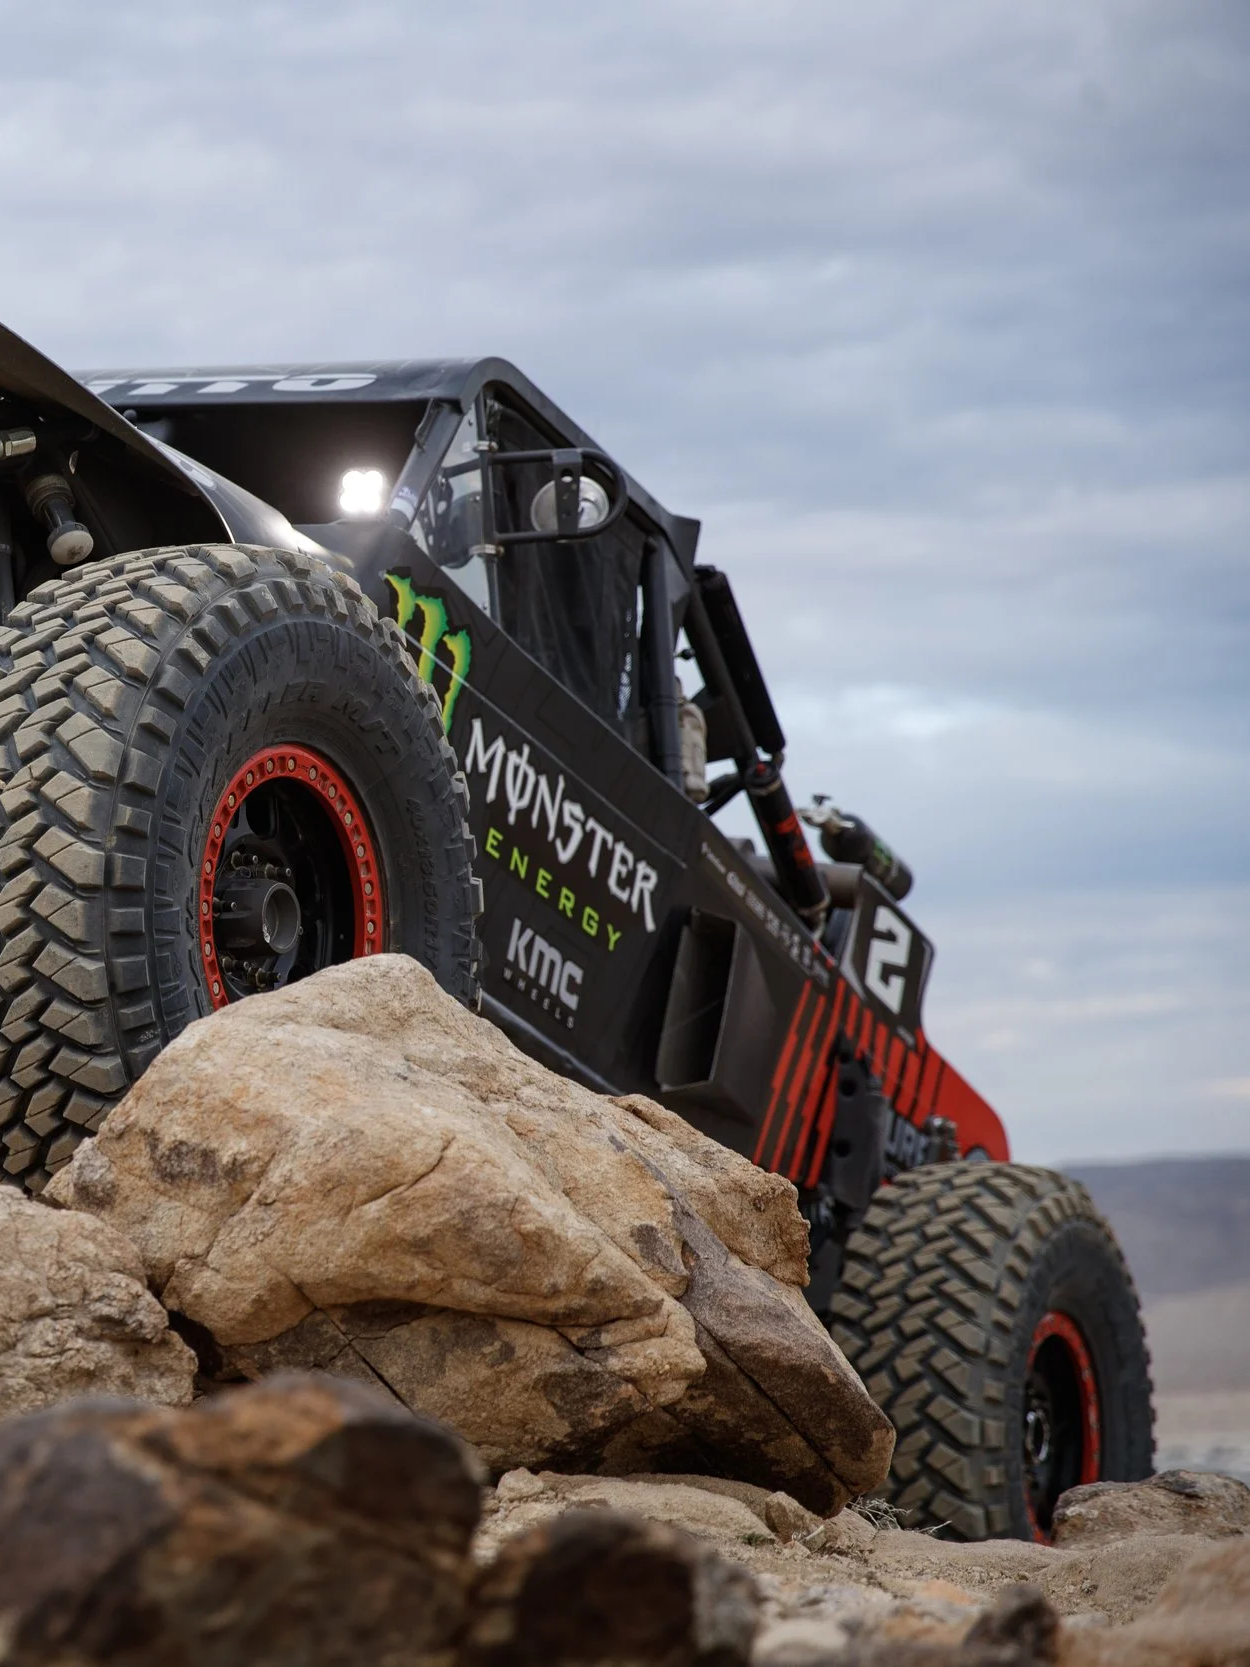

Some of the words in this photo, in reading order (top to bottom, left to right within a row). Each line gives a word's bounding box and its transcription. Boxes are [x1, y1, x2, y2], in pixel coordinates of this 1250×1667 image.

[465, 718, 658, 933] MONSTER
[485, 827, 622, 951] ENERGY
[503, 967, 575, 1029] WHEELS
[506, 917, 584, 1011] KMC
[864, 905, 912, 1015] 2
